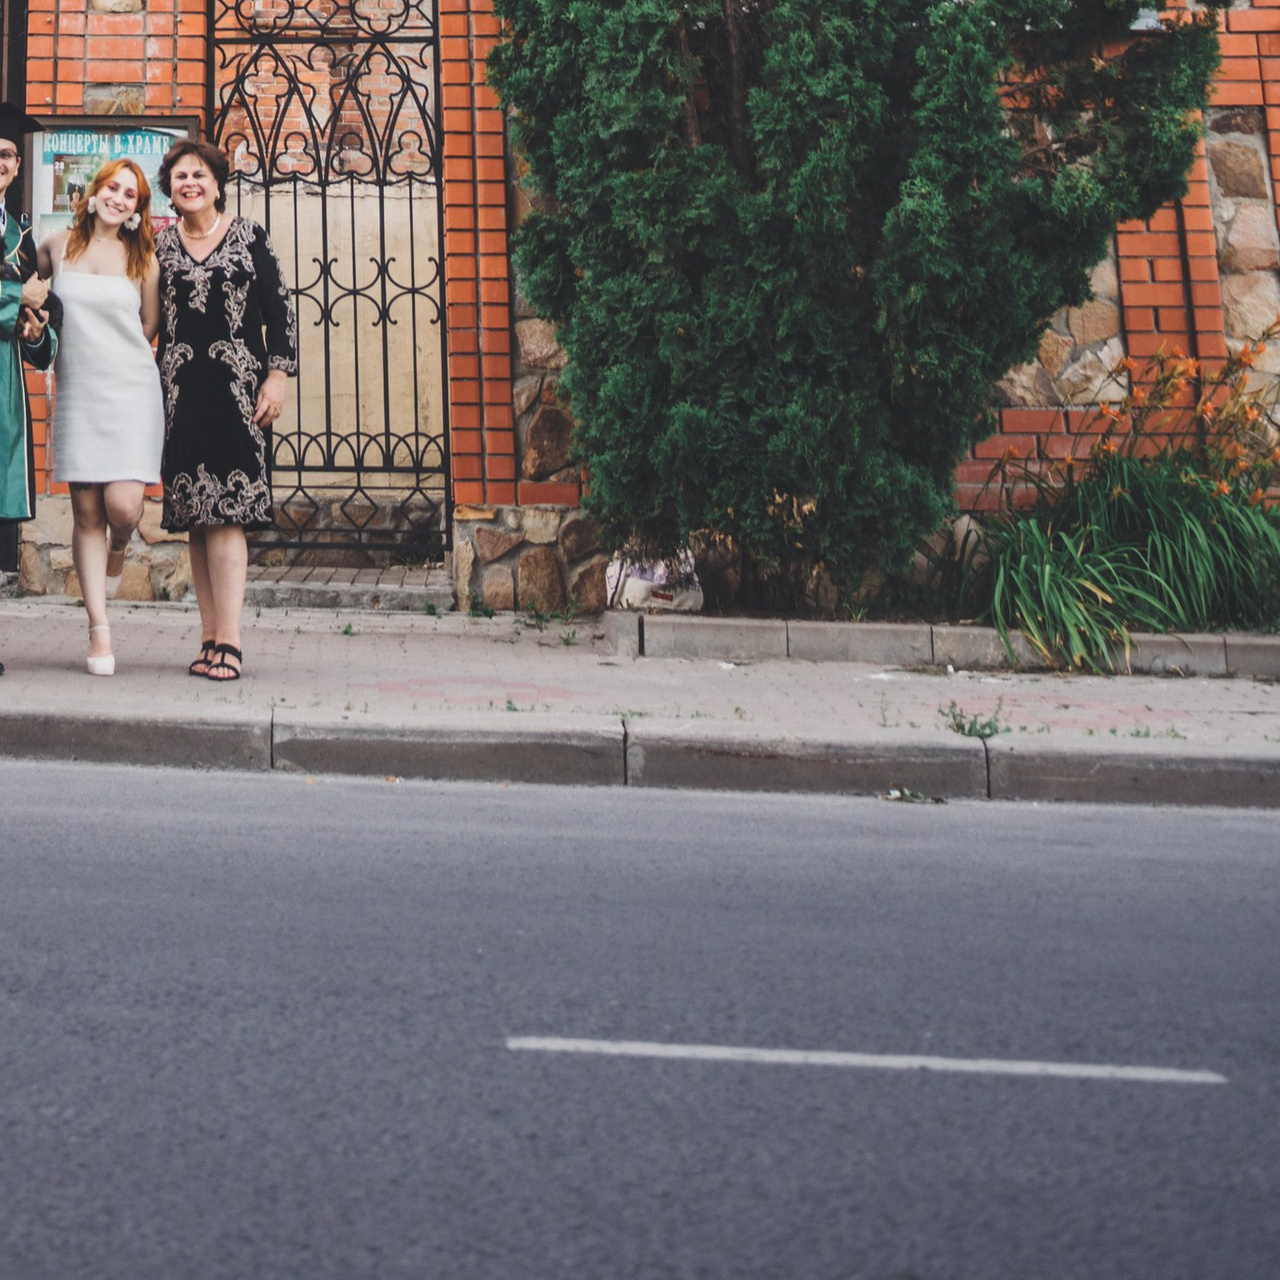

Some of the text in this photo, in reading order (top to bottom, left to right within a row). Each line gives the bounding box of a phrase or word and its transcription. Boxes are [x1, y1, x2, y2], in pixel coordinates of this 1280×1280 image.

[44, 133, 170, 154] КОНЦЕРТЫ В ХРАМЕ
